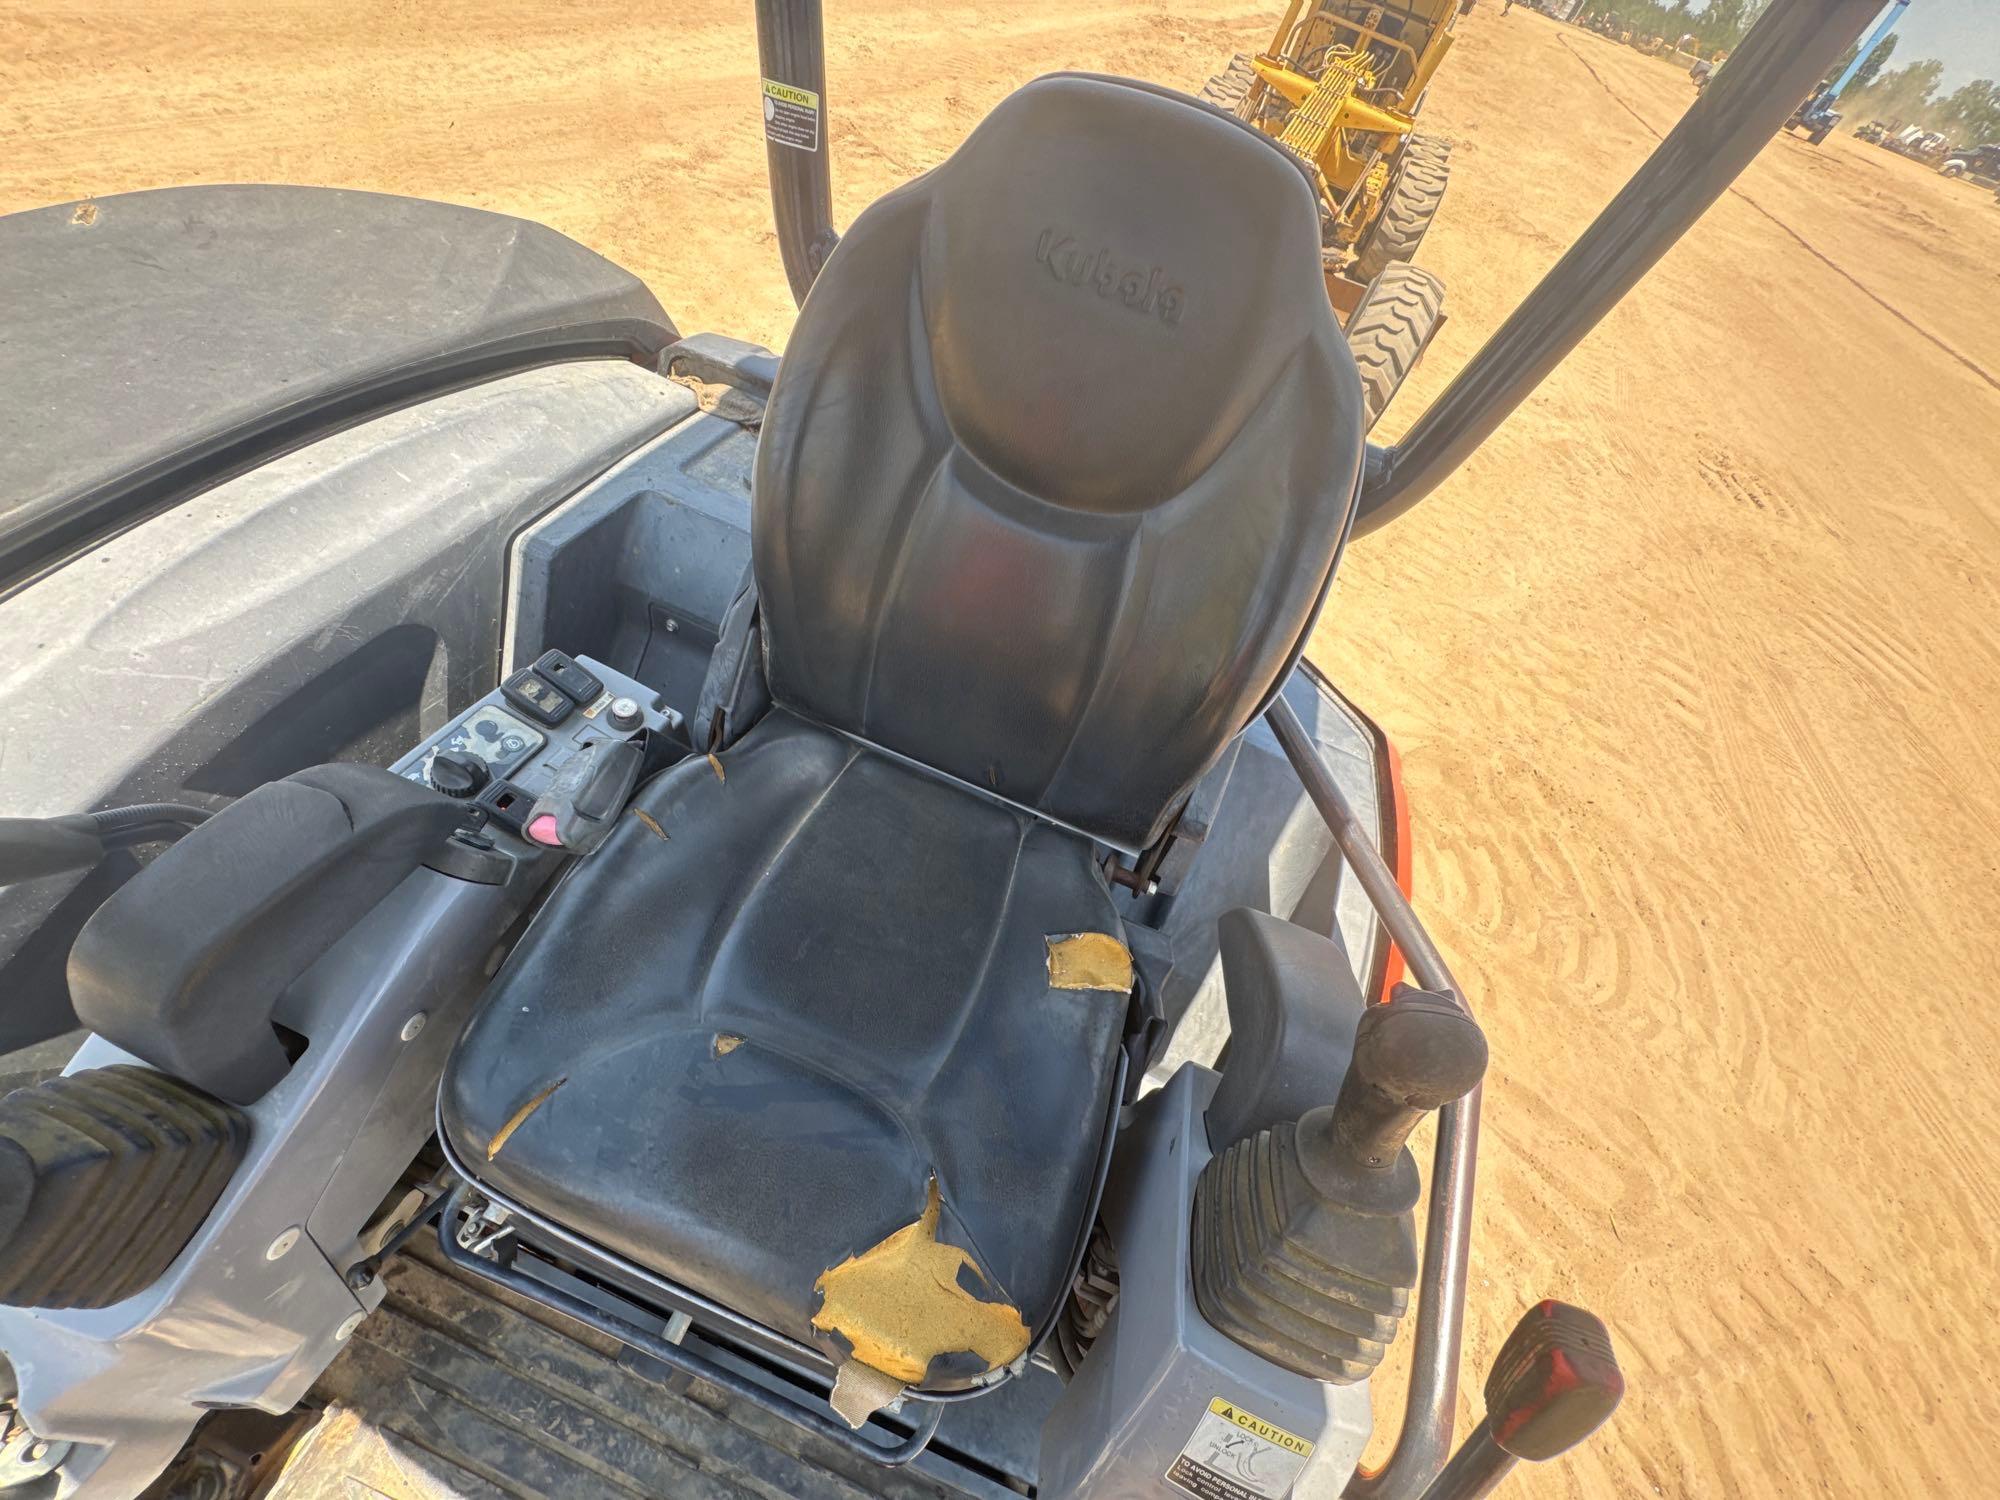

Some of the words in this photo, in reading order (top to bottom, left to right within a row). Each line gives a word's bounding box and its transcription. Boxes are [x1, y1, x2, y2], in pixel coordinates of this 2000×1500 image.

[770, 85, 809, 104] CAUTION
[1034, 227, 1185, 324] Kubota
[1236, 1432, 1254, 1443] LOCK
[1238, 1415, 1305, 1452] CAUTION
[1209, 1441, 1236, 1459] UNLOCK
[1172, 1470, 1198, 1488] leaving
[1177, 1465, 1193, 1477] Lock
[1196, 1477, 1221, 1493] control
[1223, 1491, 1243, 1500] leve
[1180, 1458, 1190, 1467] TO
[1190, 1465, 1212, 1479] AVOID
[1211, 1476, 1248, 1498] PERSONAL
